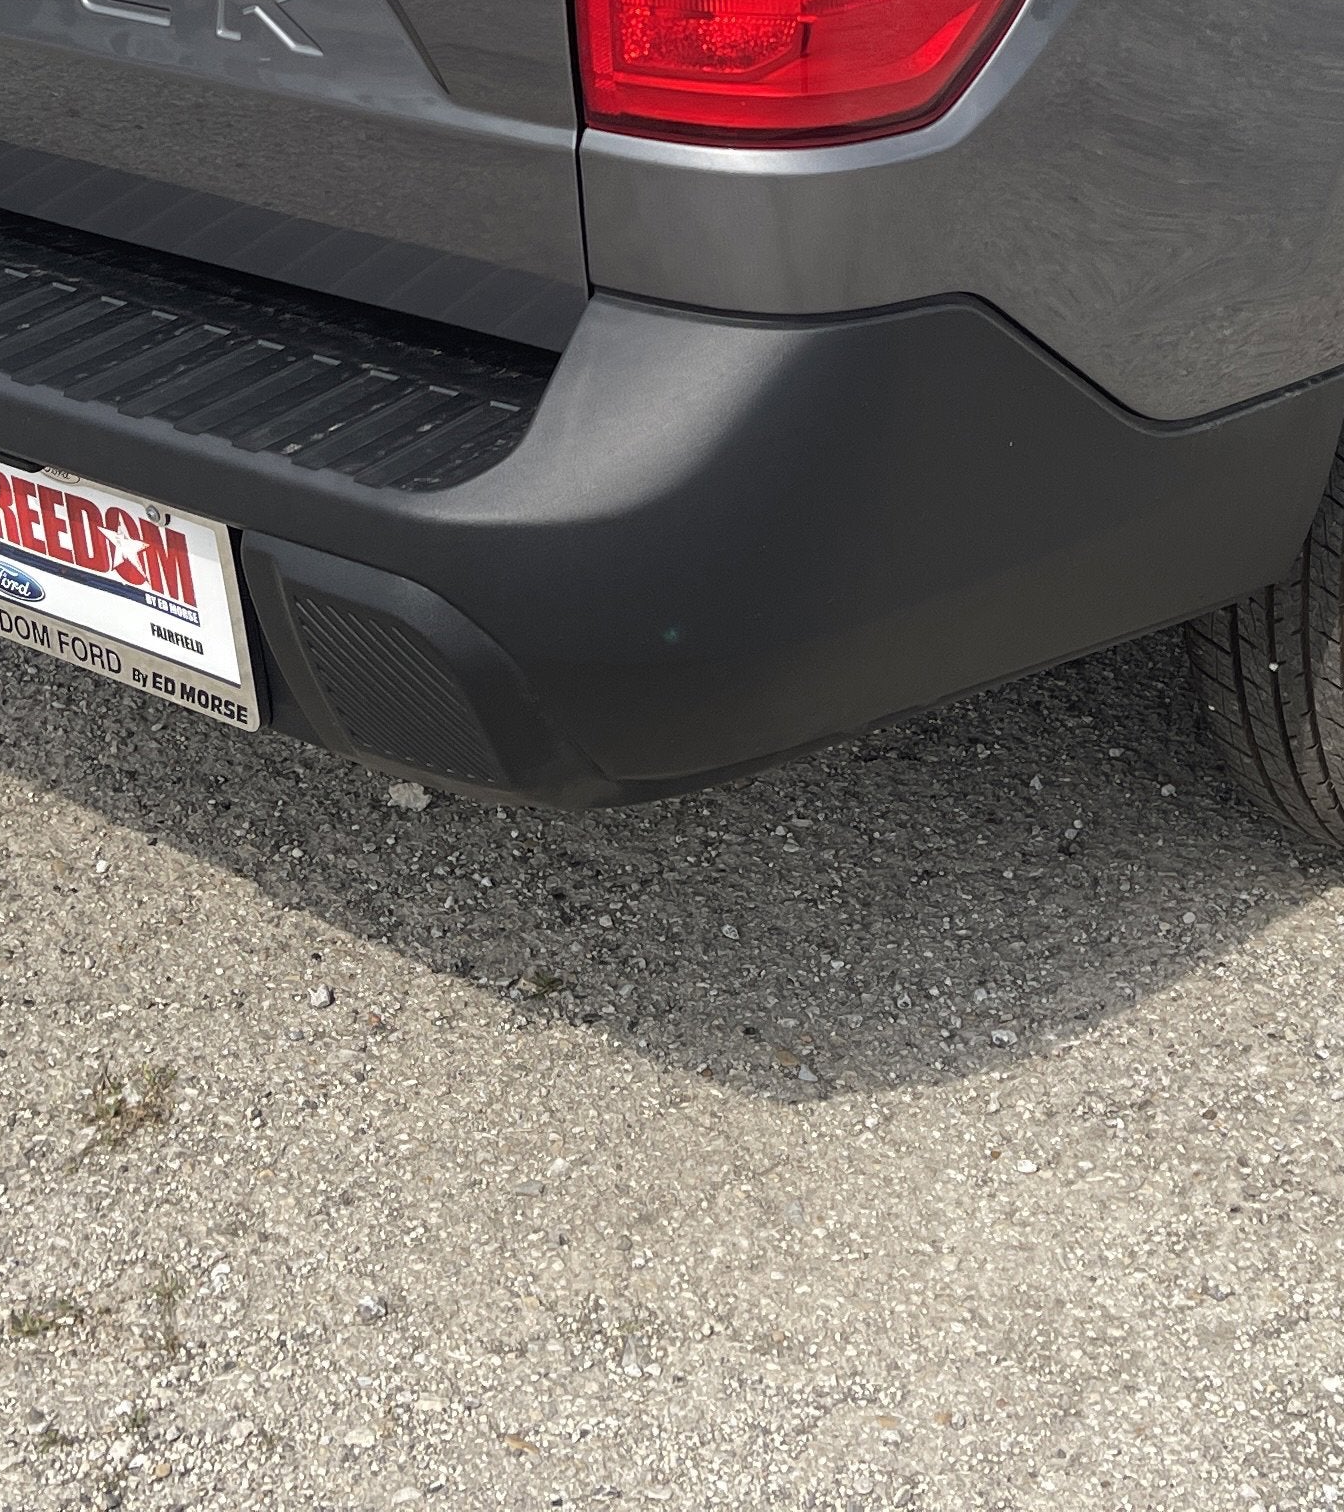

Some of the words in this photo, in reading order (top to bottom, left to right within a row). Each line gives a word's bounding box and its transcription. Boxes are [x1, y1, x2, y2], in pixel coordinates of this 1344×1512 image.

[145, 593, 156, 607] BY
[157, 597, 168, 612] ED
[169, 602, 198, 624] MORSE
[150, 622, 204, 655] FAIRFIELD
[57, 630, 122, 674] FORD
[152, 671, 175, 695] ED
[180, 682, 248, 724] MORSE
